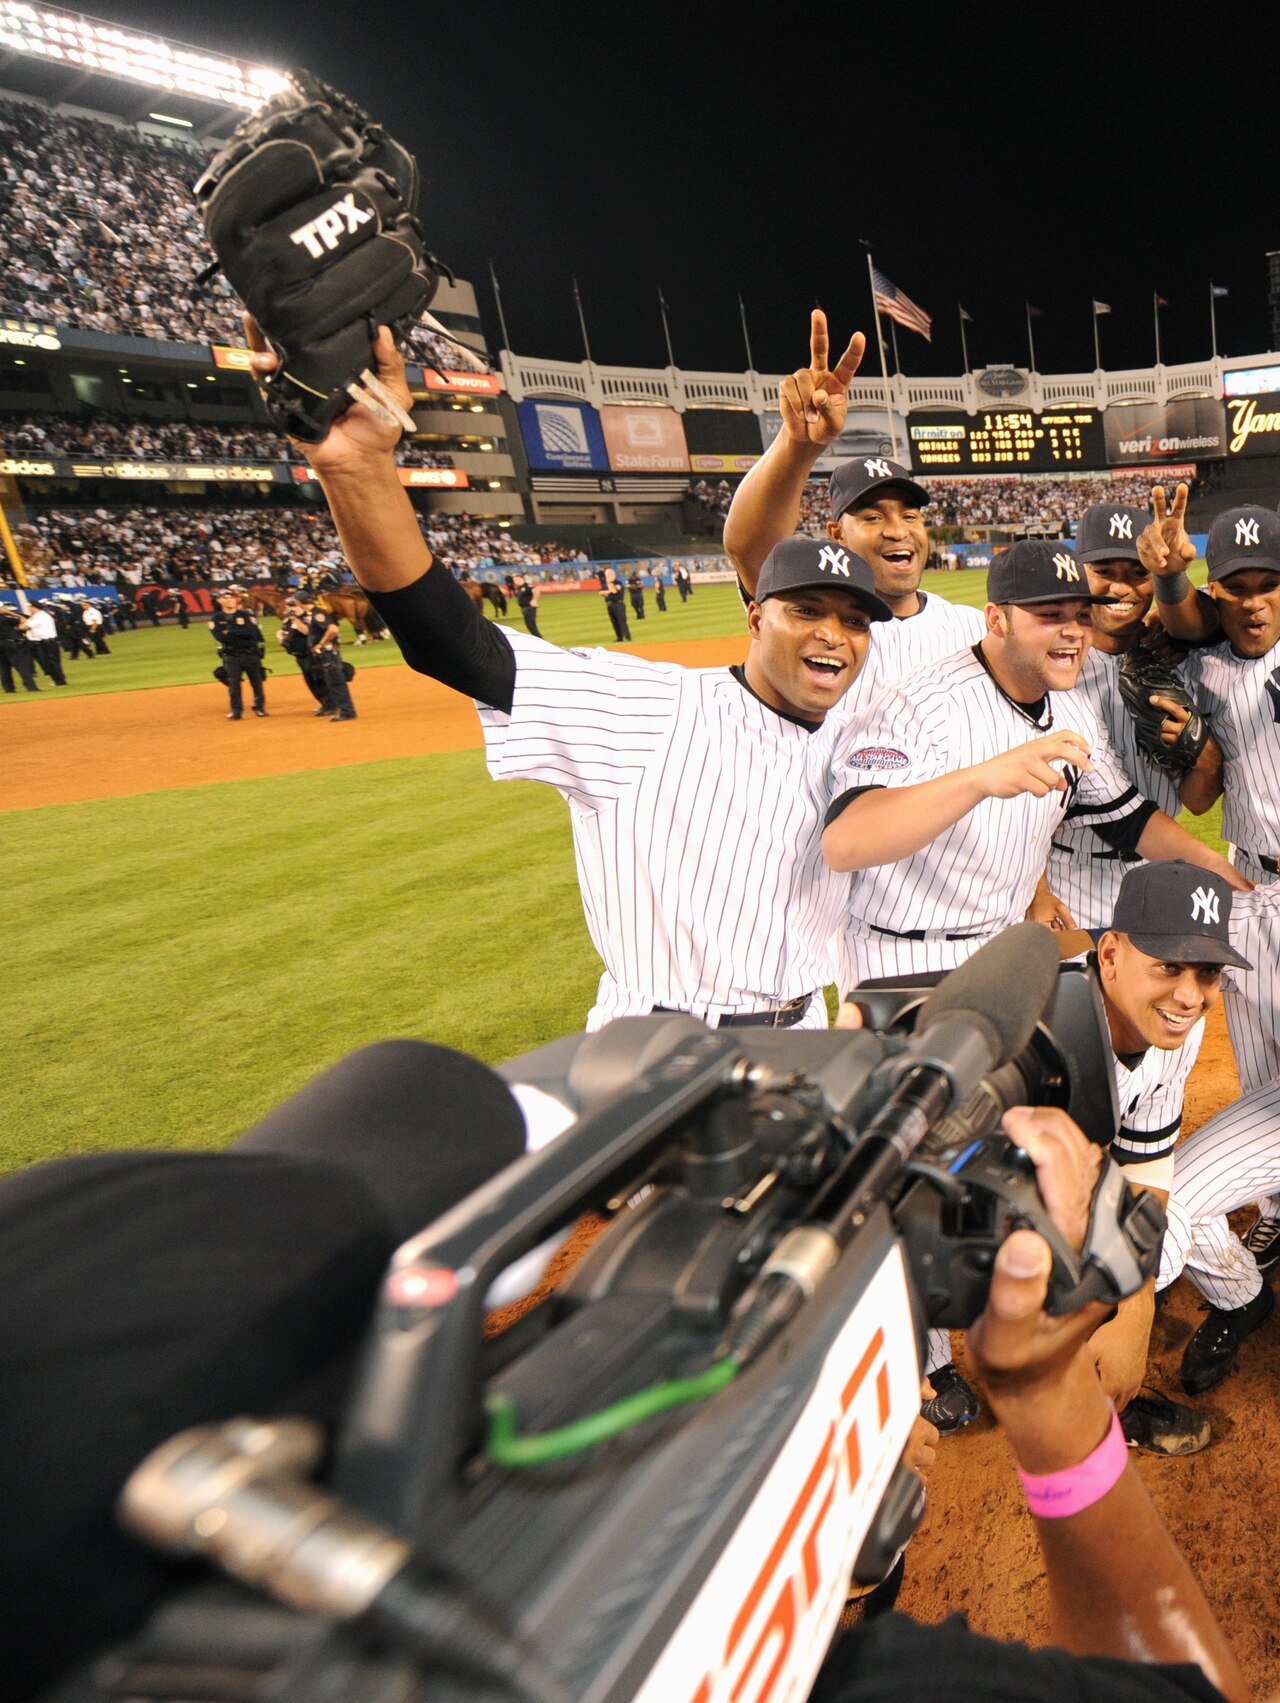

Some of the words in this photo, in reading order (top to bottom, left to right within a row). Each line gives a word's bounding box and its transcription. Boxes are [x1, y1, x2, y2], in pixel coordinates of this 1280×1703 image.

[289, 193, 372, 258] TPX
[449, 377, 491, 388] TOYOTA
[984, 414, 1033, 430] 11:54
[914, 427, 963, 439] Armitron
[103, 462, 169, 479] adidas
[215, 465, 273, 481] adidas
[864, 458, 893, 478] NY
[1109, 513, 1133, 539] NY
[1235, 517, 1260, 546] NY
[818, 545, 851, 578] NY
[966, 556, 988, 567] 399
[1052, 553, 1080, 582] NY
[1190, 886, 1220, 926] NY
